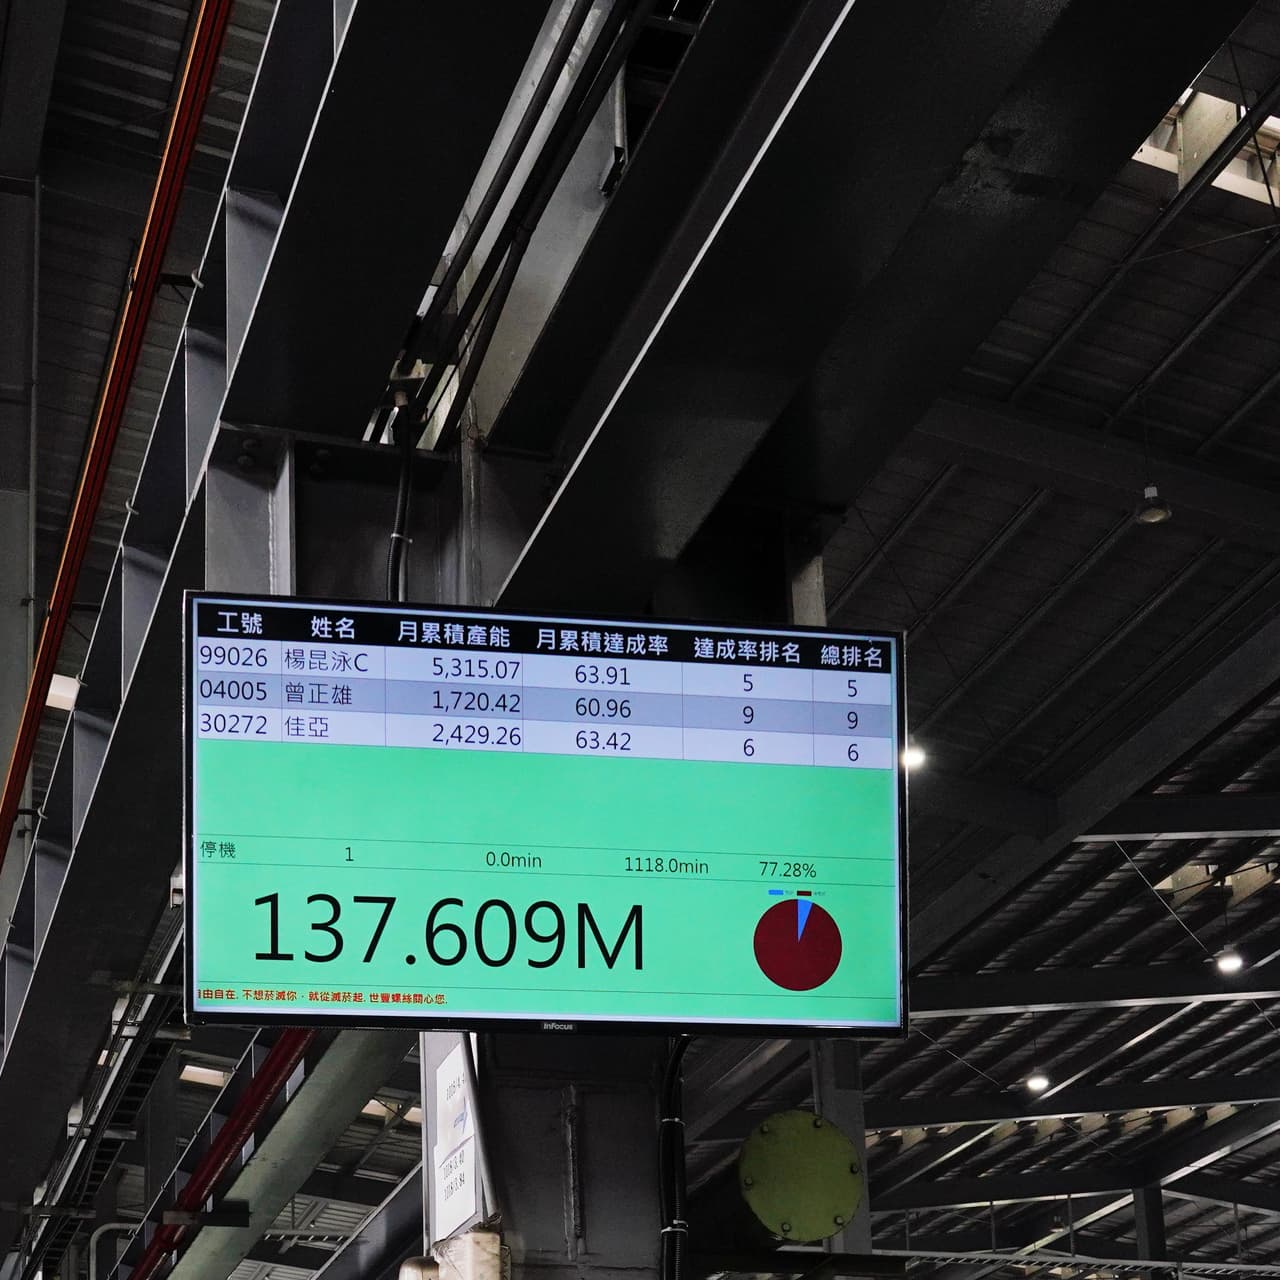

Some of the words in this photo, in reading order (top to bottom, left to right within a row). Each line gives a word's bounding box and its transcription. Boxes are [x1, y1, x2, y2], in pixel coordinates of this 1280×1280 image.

[218, 612, 262, 635] 工號
[311, 616, 355, 639] 姓名
[398, 621, 510, 647] 月累積產能
[537, 629, 668, 655] 月累積達成率
[694, 637, 800, 663] 達成率排名
[821, 644, 882, 668] 總排名
[200, 645, 267, 667] 99026
[432, 657, 520, 680] 5,315.07
[575, 665, 630, 685] 63.91
[743, 674, 754, 691] 5
[847, 680, 857, 697] 5
[200, 679, 267, 701] 04005
[285, 682, 352, 706] 曾正雄
[433, 691, 520, 714] 1,720.42
[575, 698, 631, 718] 60.96
[743, 706, 754, 724] 9
[847, 712, 858, 729] 9
[200, 713, 267, 735] 30272
[285, 716, 329, 738] 佳亞
[433, 724, 521, 746] 2,429.26
[575, 730, 631, 751] 63.42
[743, 739, 755, 756] 6
[848, 744, 859, 761] 6
[199, 840, 236, 859] 停機
[345, 847, 354, 862] 1
[485, 850, 542, 868] 0.0min
[624, 856, 709, 875] 1118.0min
[759, 861, 817, 879] 77.28%
[254, 892, 644, 971] 137.609M
